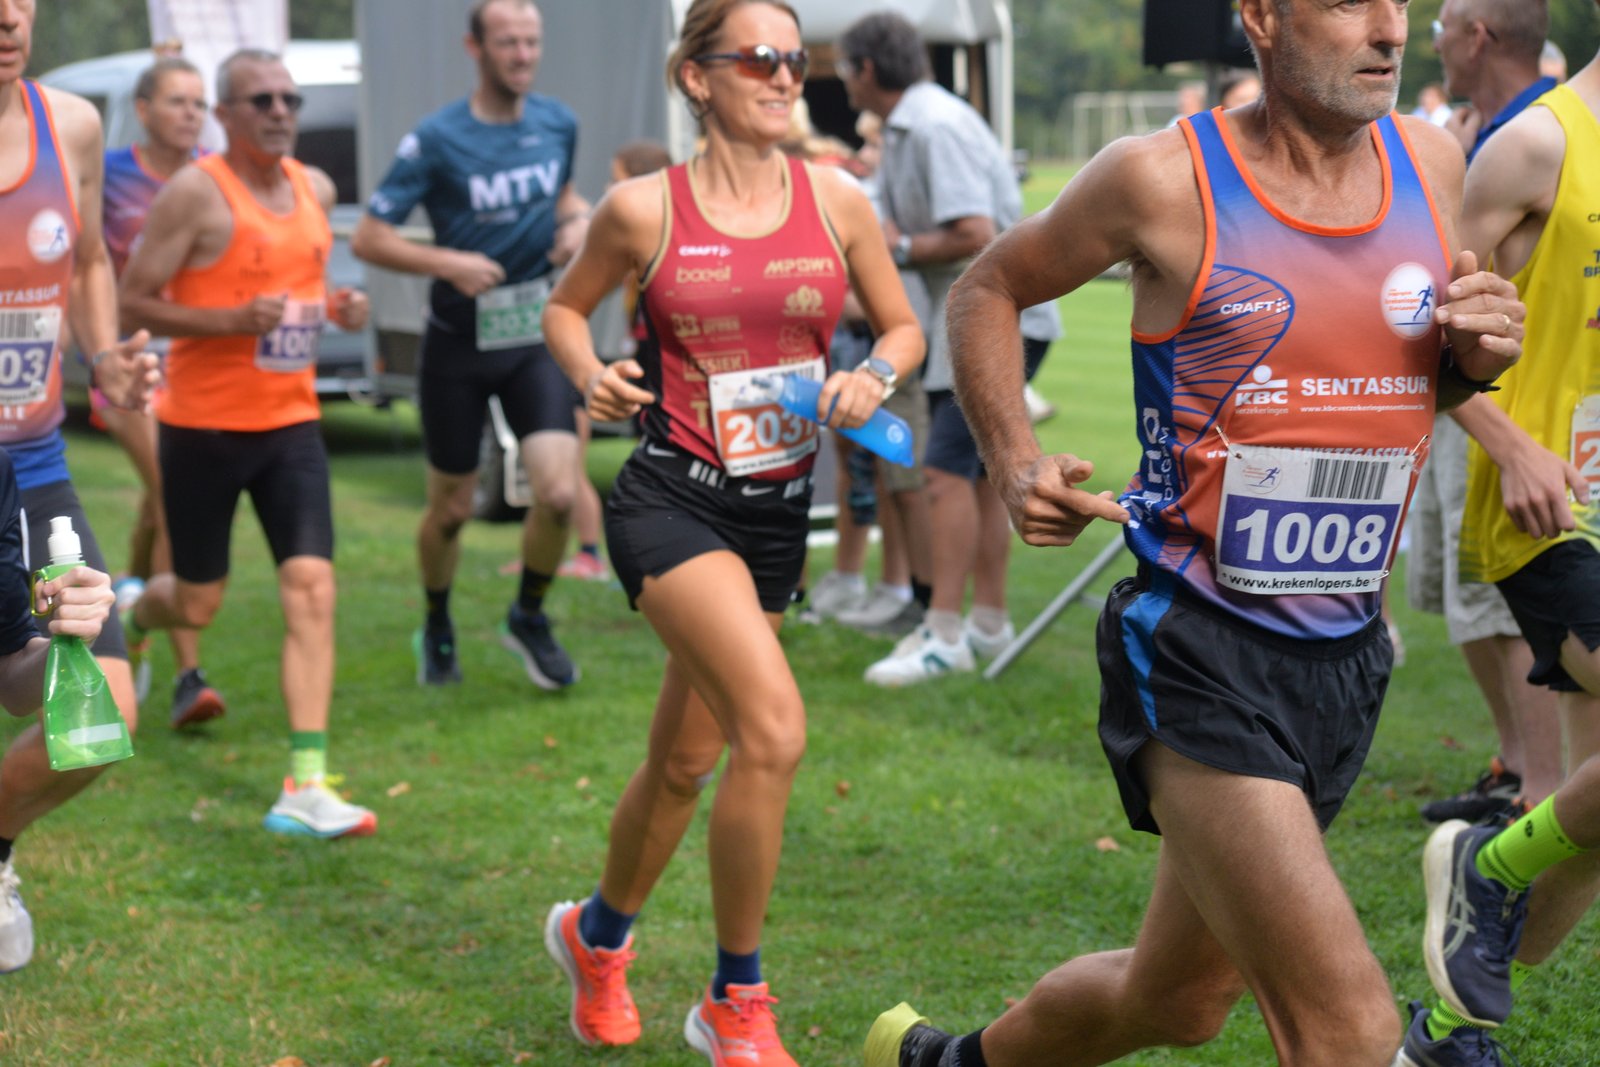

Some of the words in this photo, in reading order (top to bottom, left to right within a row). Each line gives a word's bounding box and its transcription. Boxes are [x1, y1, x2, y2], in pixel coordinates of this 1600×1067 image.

[468, 159, 560, 211] MTV
[678, 245, 720, 257] CRAFT
[1220, 300, 1276, 315] CRAFT
[1235, 391, 1288, 406] KBC
[1300, 375, 1429, 397] SENTASSUR
[1235, 509, 1387, 564] 1008
[1229, 573, 1370, 590] www.krekenlopers.be
